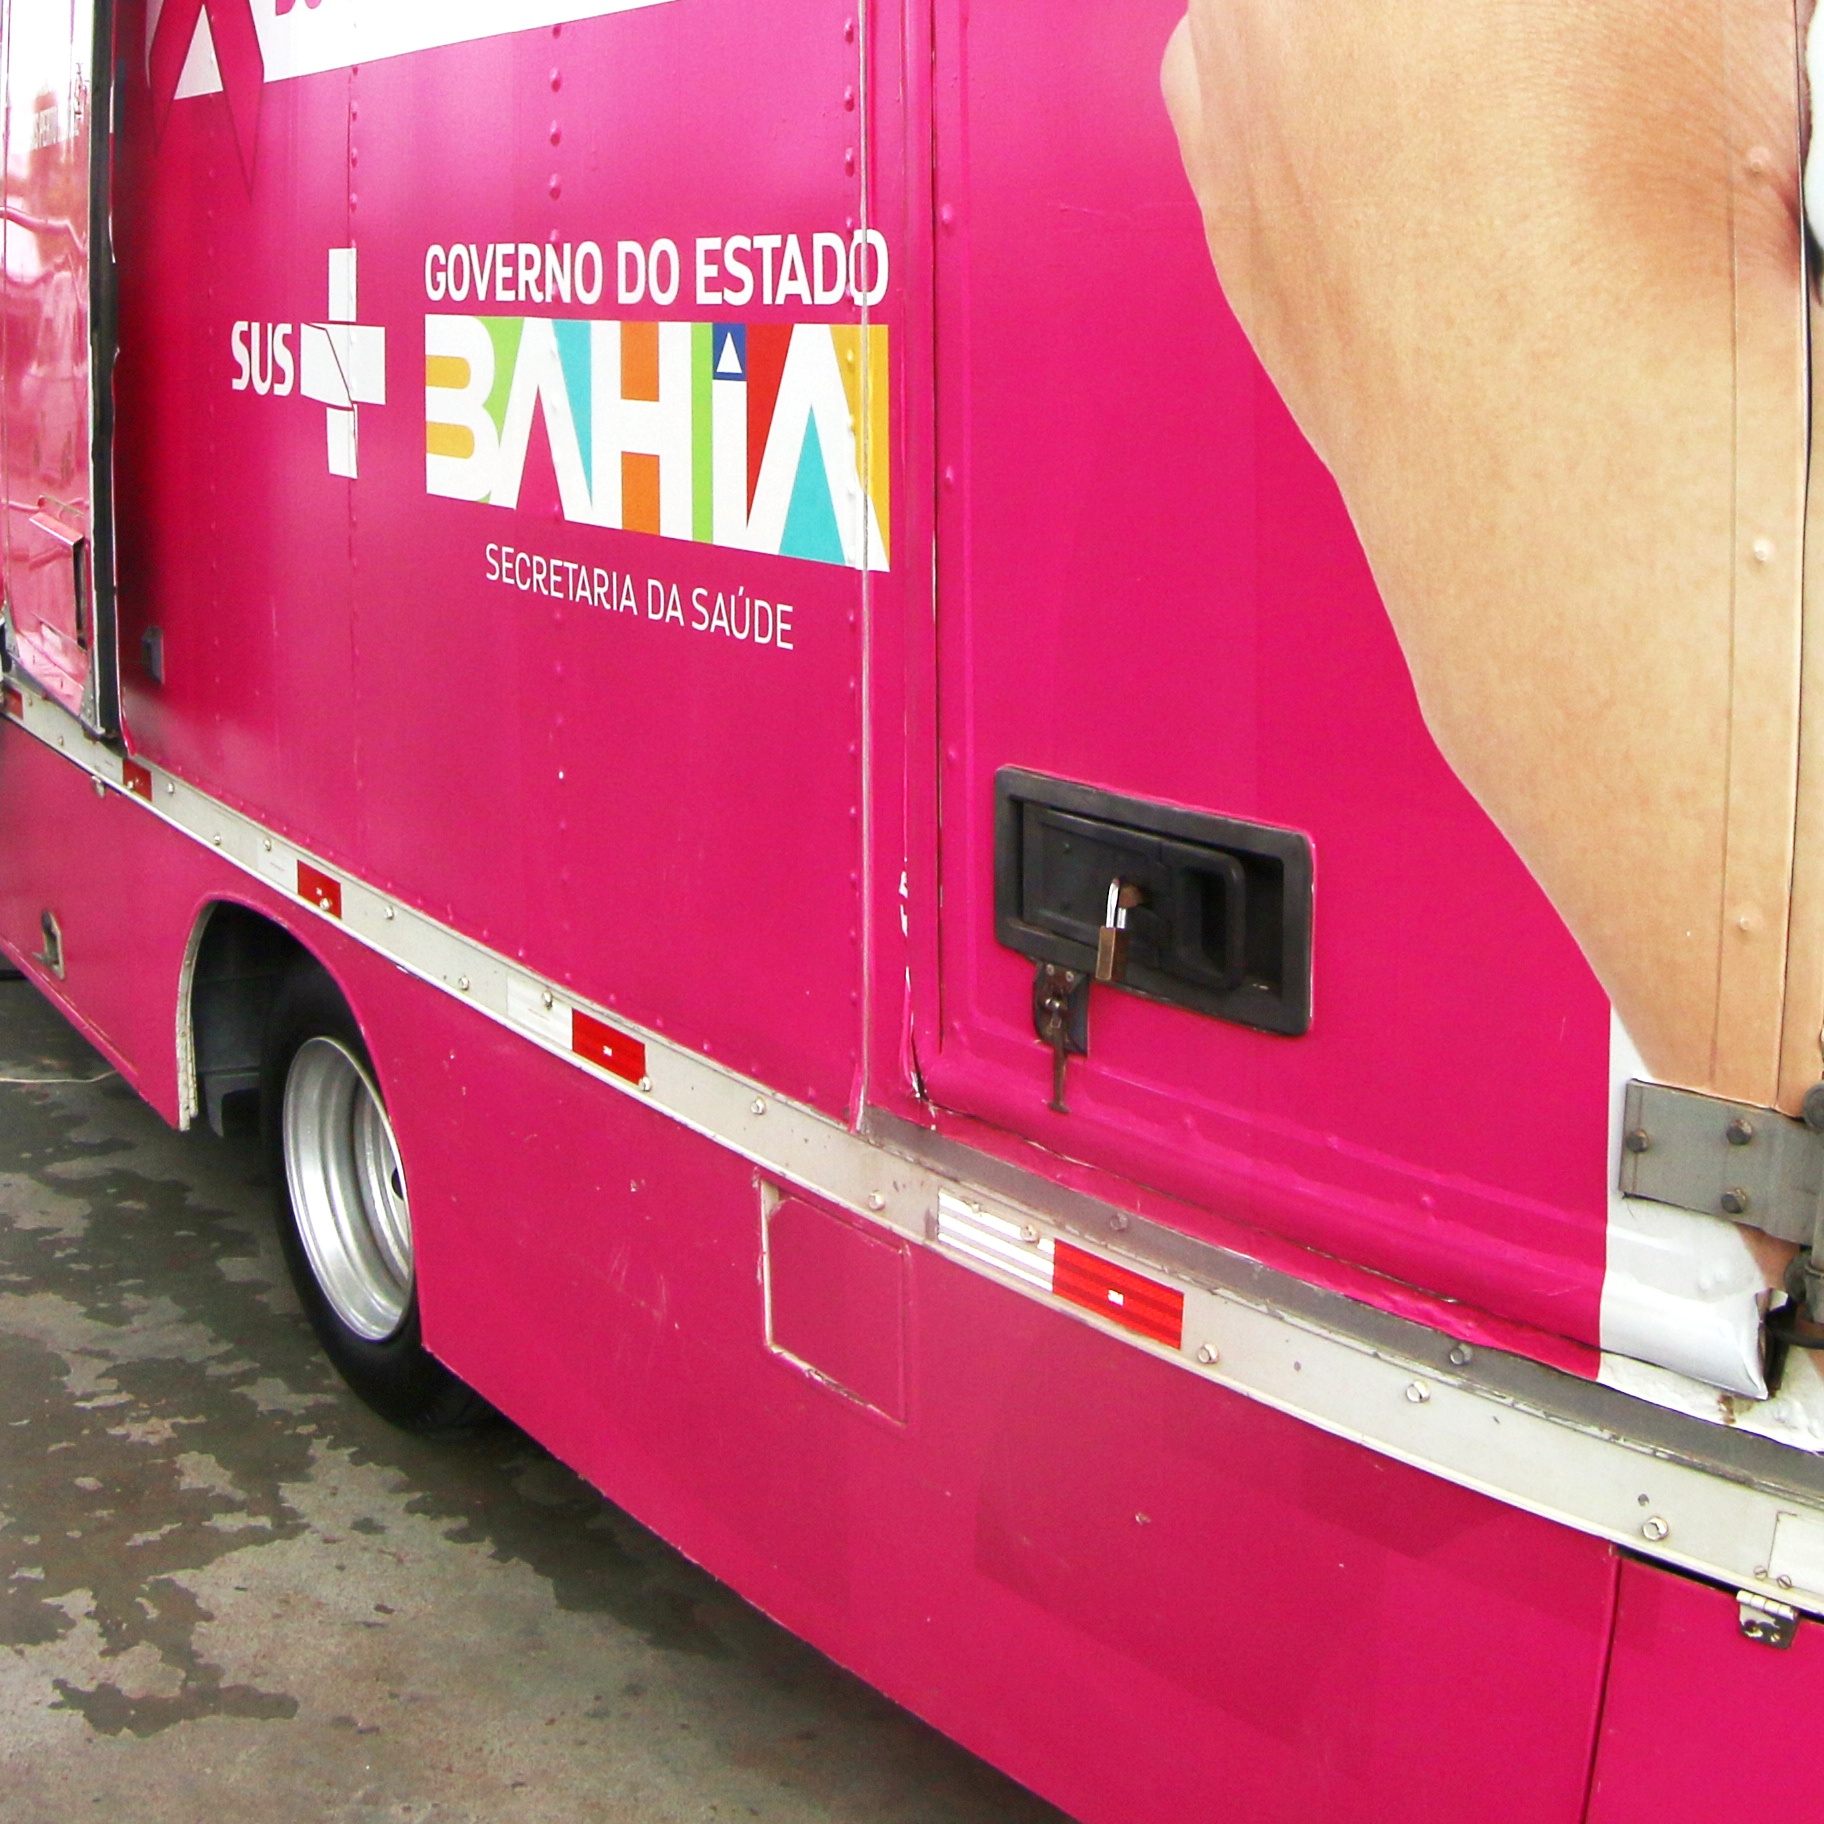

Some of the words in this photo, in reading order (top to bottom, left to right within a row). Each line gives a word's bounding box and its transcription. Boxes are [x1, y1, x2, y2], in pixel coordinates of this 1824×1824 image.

[424, 240, 604, 305] GOVERNO
[616, 238, 681, 306] DO
[695, 229, 891, 307] ESTADO
[231, 320, 293, 397] SUS
[424, 314, 891, 574] BAHIA
[485, 542, 638, 617] SECRETARIA
[646, 580, 684, 629] DA
[691, 585, 794, 651] SAÚDE
